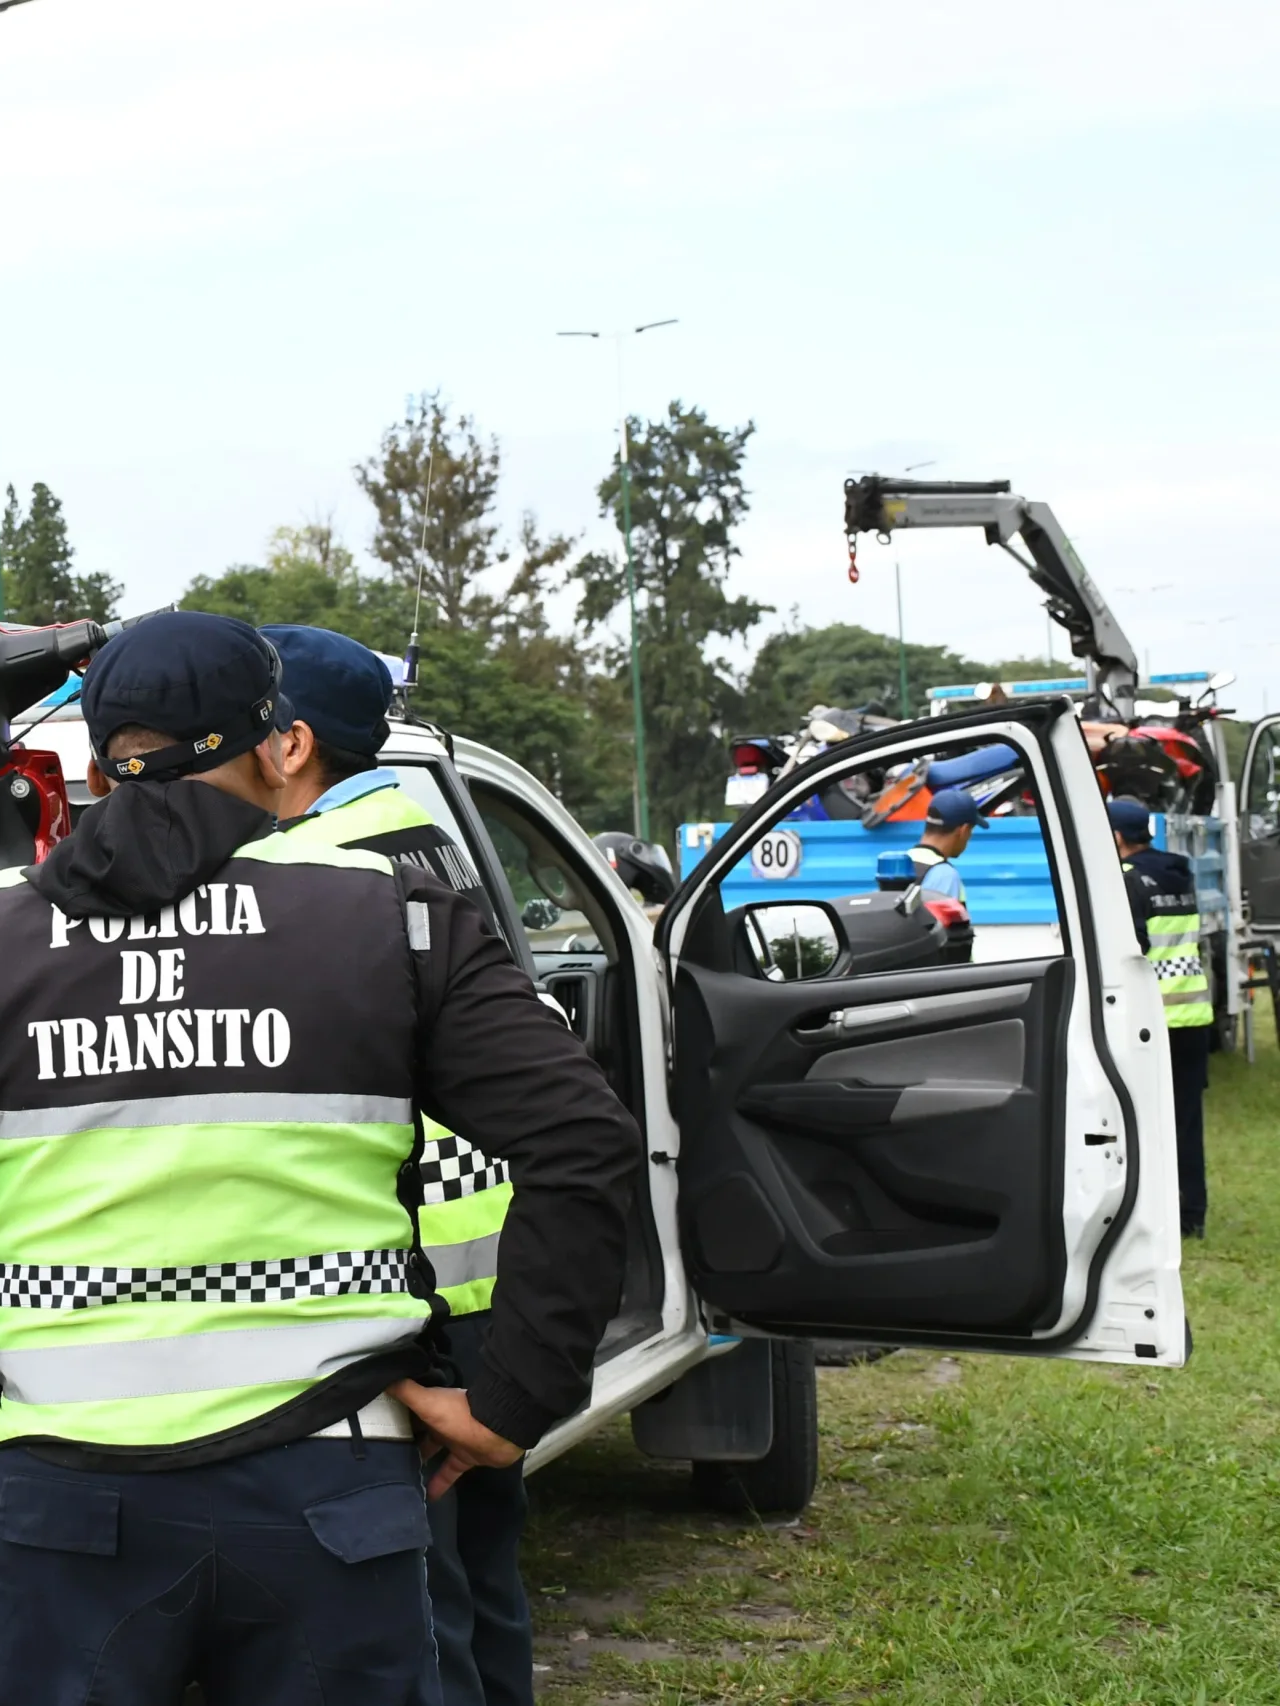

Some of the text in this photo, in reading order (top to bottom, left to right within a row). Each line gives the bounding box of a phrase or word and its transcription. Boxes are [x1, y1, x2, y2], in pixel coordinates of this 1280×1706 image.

[761, 840, 788, 868] 80
[119, 948, 186, 1005] DE
[27, 1007, 292, 1080] TRANSITO
